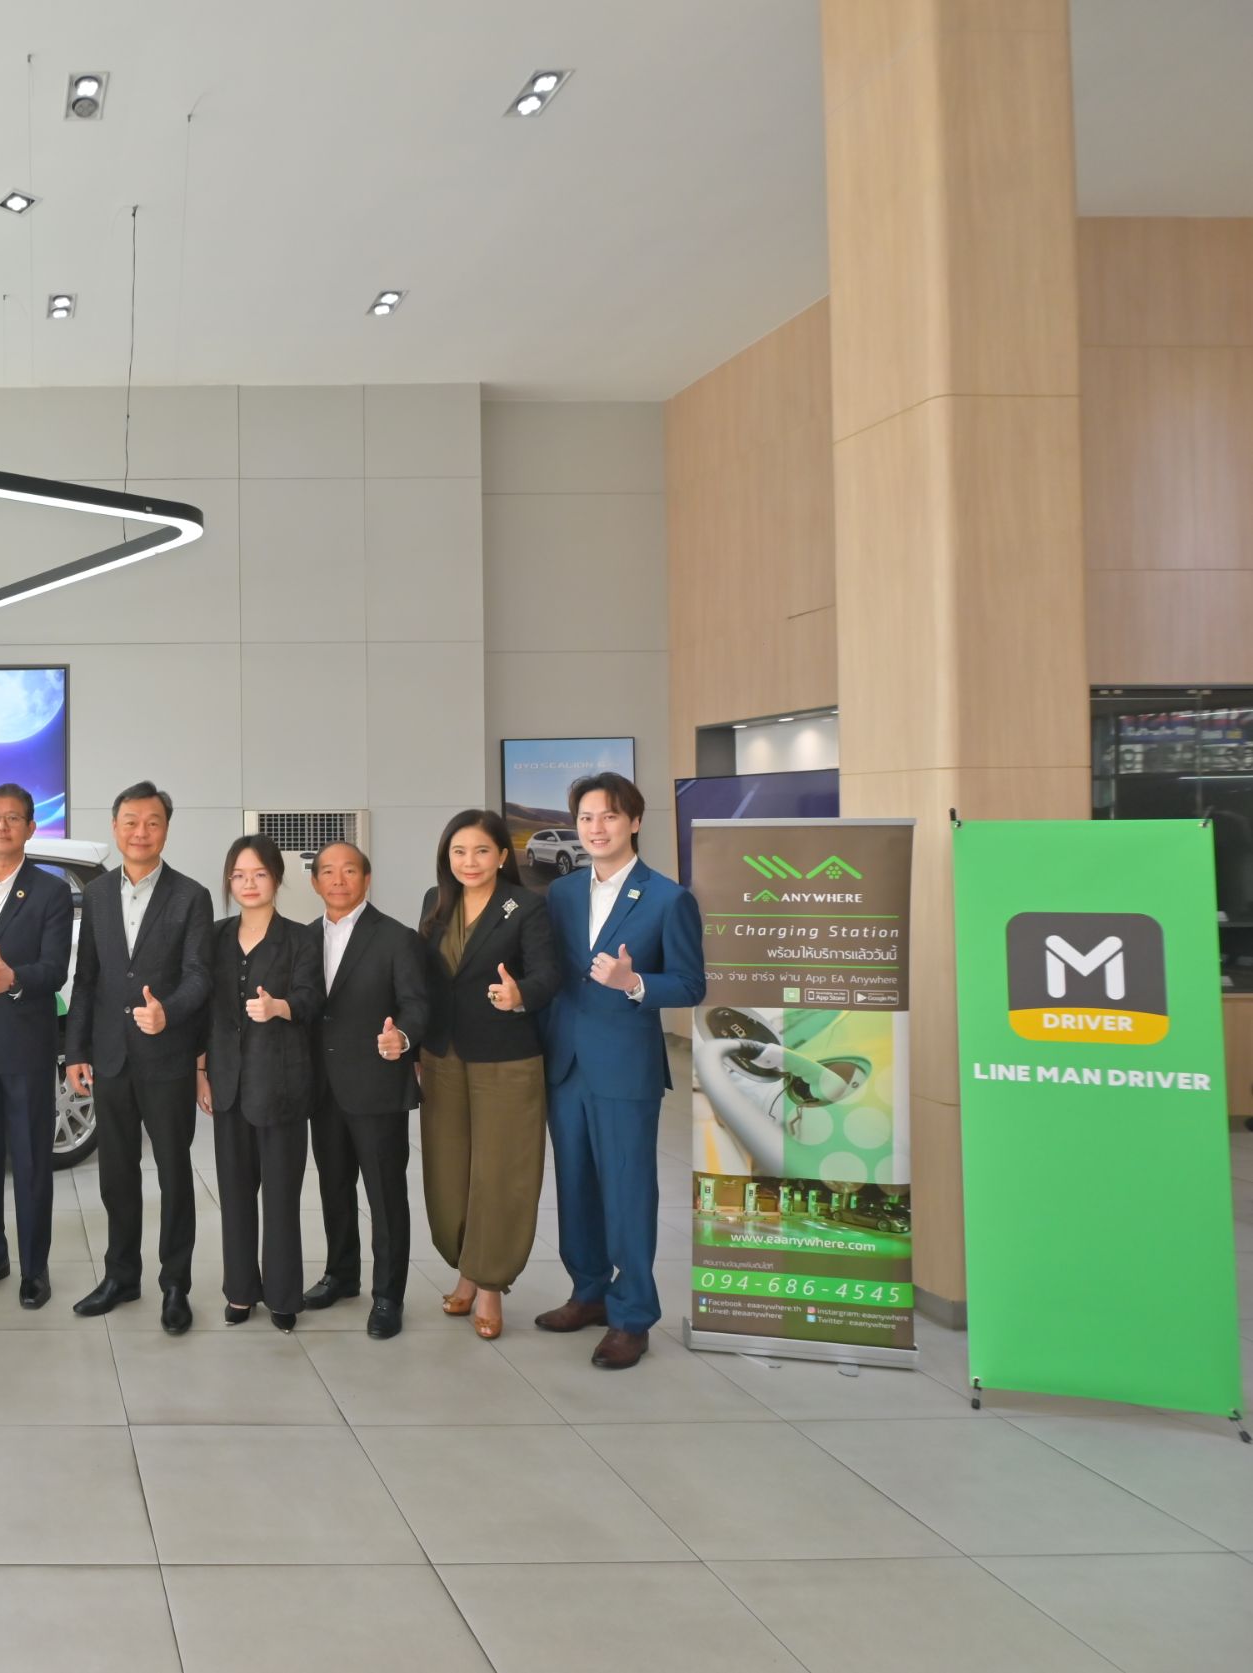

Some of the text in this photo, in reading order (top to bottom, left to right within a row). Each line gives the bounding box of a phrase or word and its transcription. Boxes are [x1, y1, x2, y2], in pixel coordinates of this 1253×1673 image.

[704, 924, 900, 939] EV Charging Station
[767, 945, 898, 961] พร้อมให้บริการแล้ววันนี้
[805, 974, 827, 984] App
[831, 975, 845, 984] EA
[850, 975, 898, 986] Anywhere
[1042, 1013, 1134, 1032] DRIVER
[973, 1062, 1212, 1091] LINE MAN DRIVER
[730, 1234, 876, 1252] www.eaanywhere.com
[701, 1272, 901, 1303] 094-686-4545
[708, 1299, 742, 1308] Facebook
[747, 1302, 802, 1313] eaanywhere.th
[817, 1316, 844, 1326] Twitter
